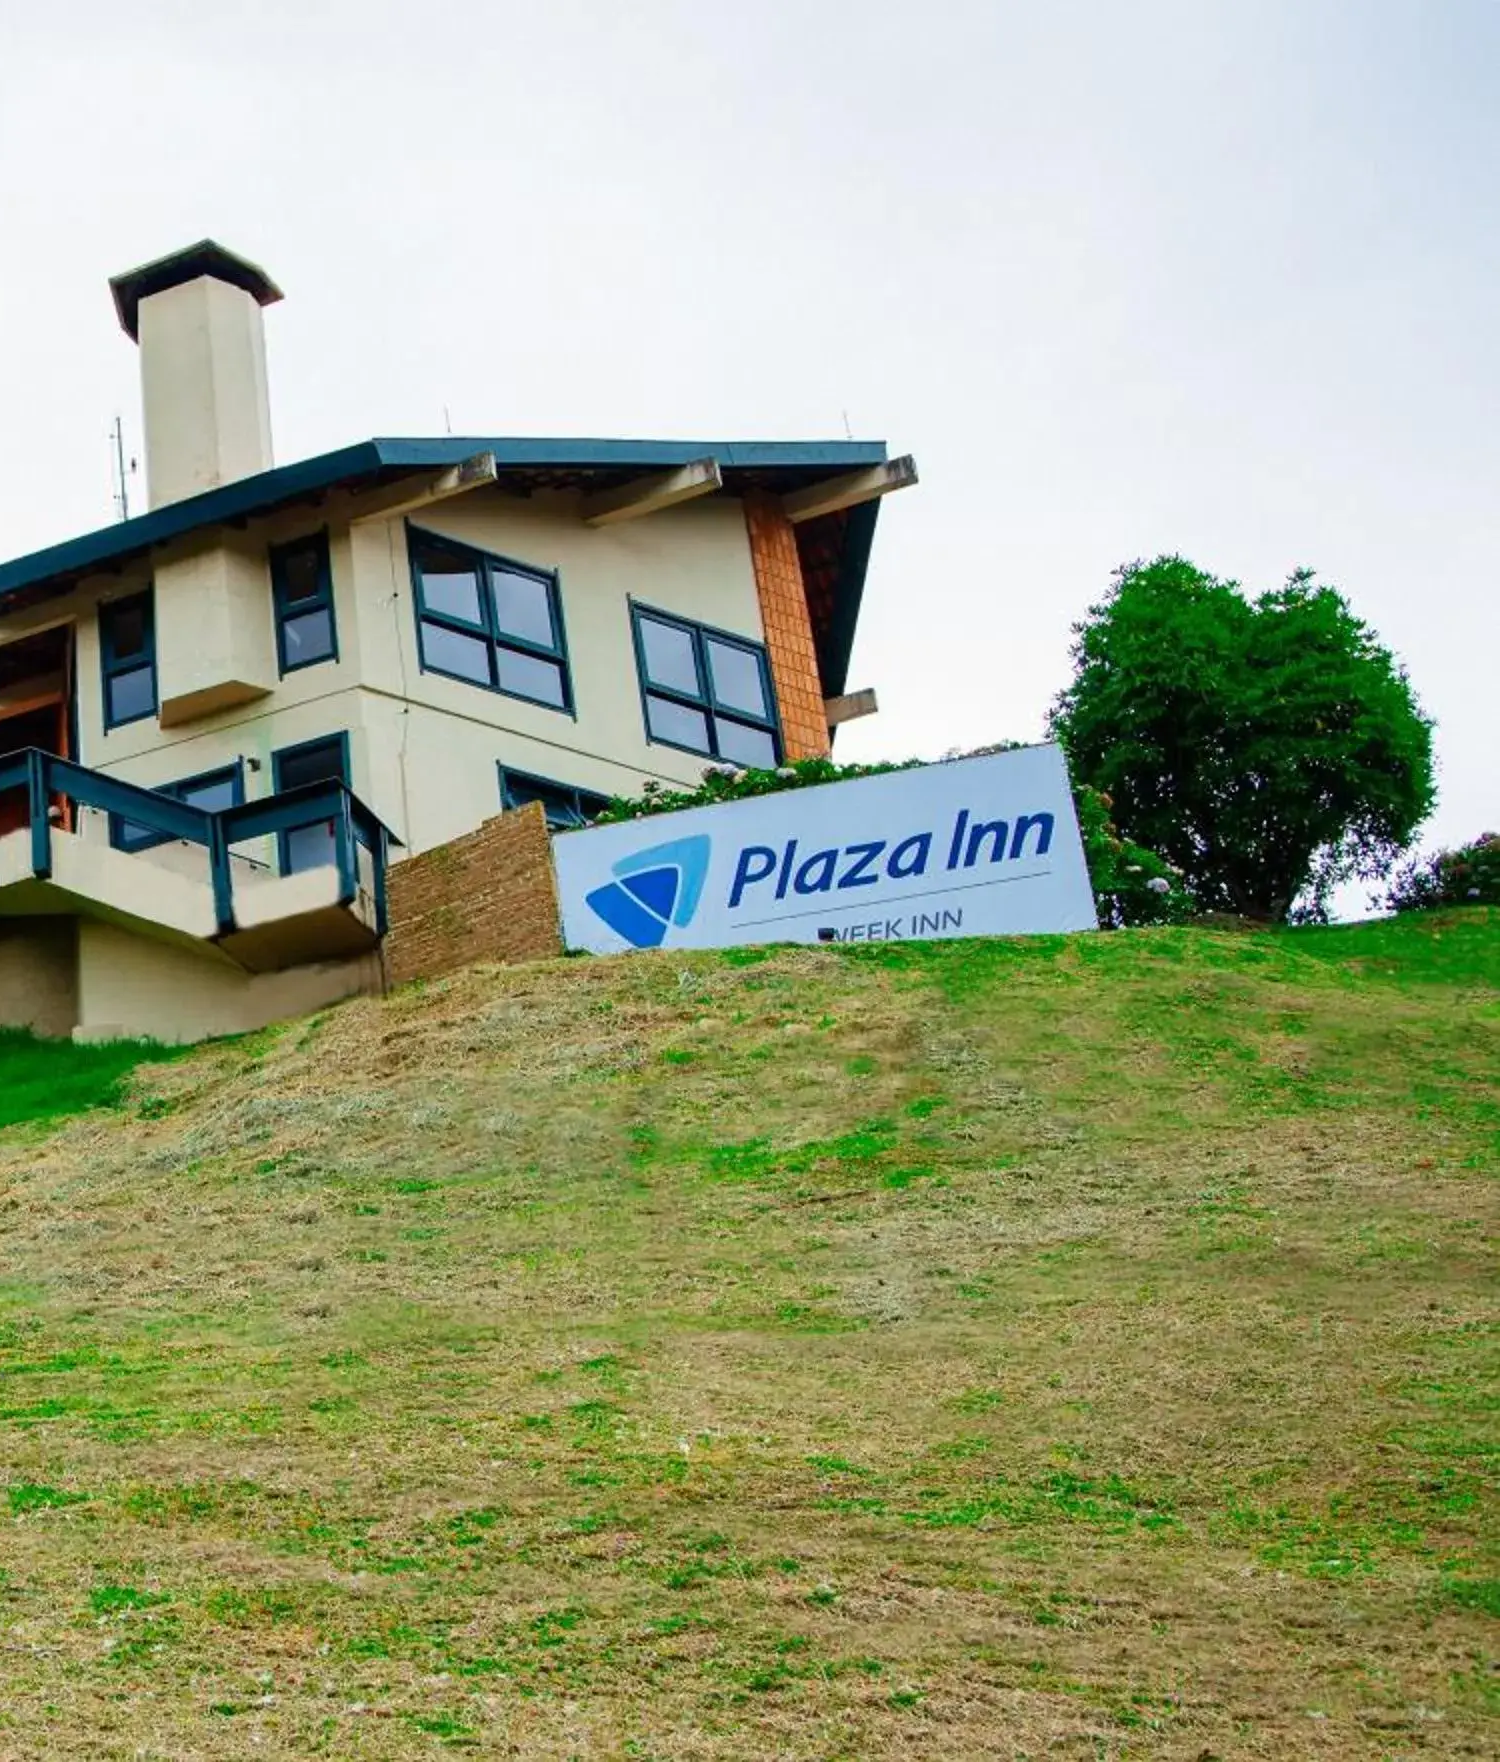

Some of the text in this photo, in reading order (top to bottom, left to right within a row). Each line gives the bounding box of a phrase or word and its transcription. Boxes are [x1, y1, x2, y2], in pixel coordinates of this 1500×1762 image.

[727, 809, 1055, 908] Plaza Inn
[911, 908, 963, 936] INN
